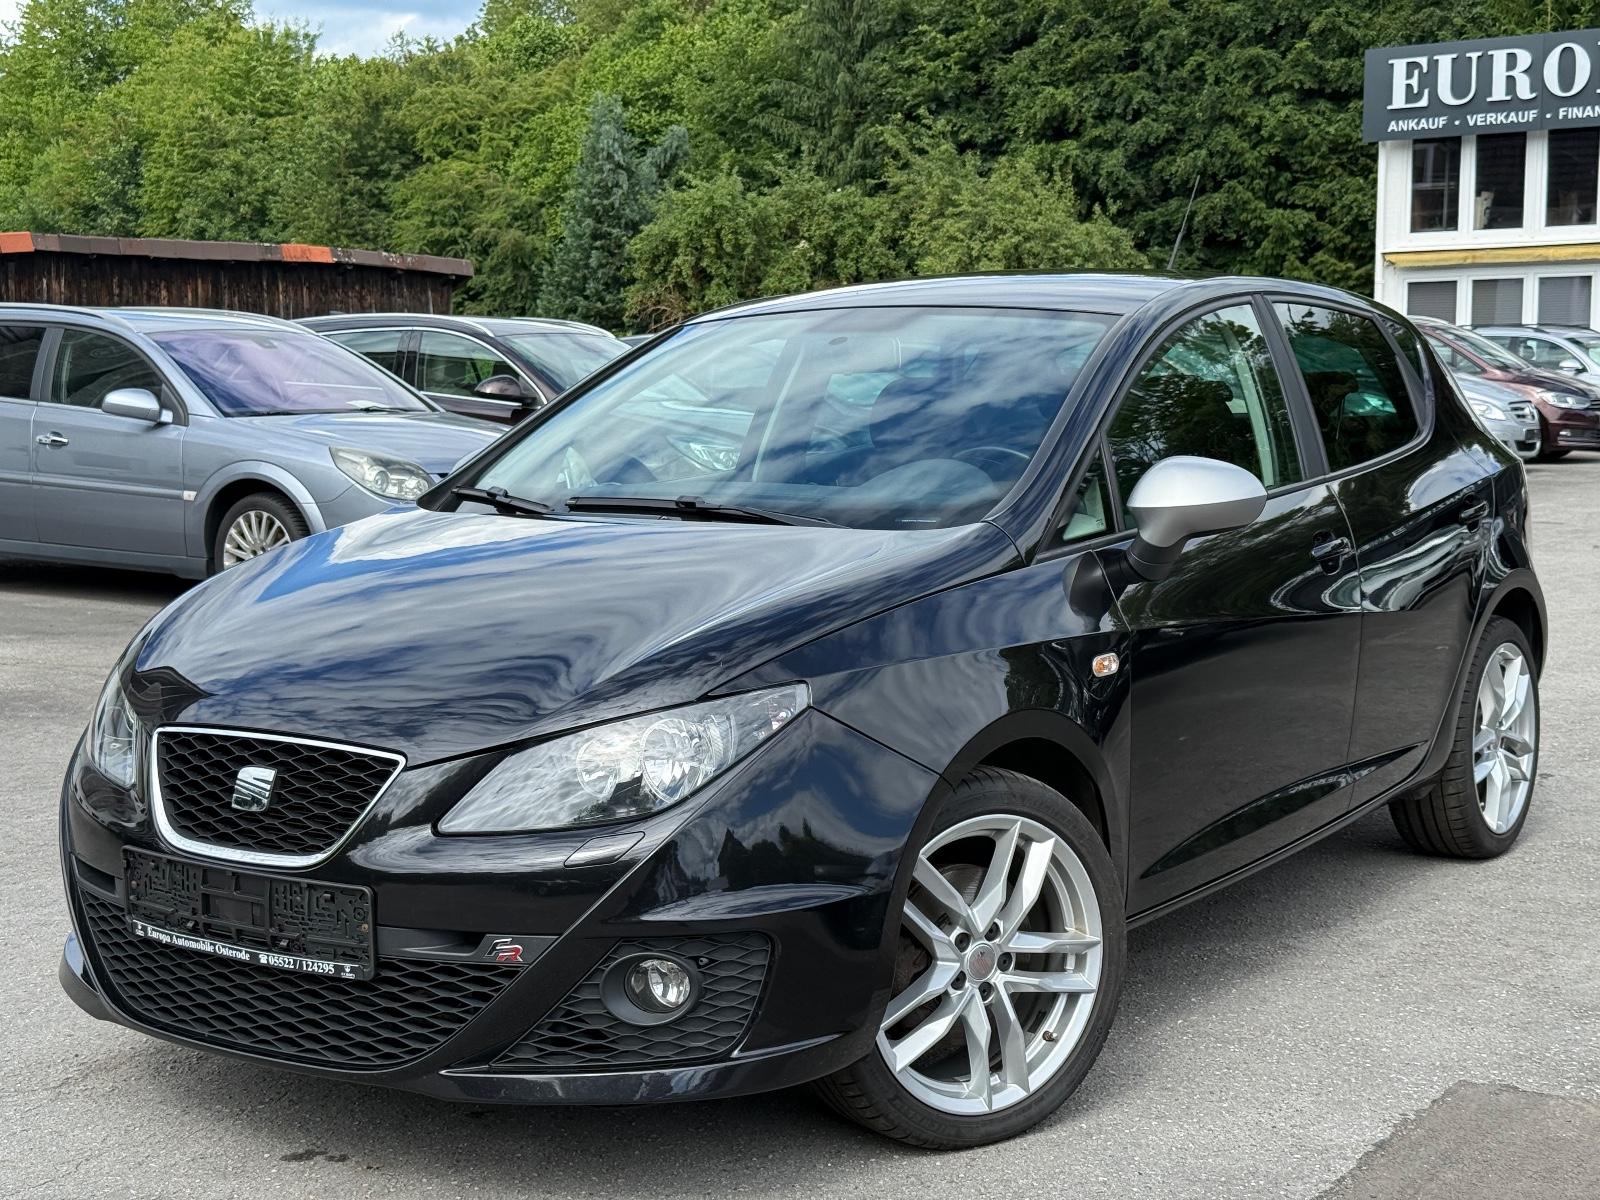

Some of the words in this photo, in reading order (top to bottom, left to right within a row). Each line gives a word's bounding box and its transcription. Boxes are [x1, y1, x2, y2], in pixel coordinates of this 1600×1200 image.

[1386, 41, 1600, 110] EURO
[1387, 115, 1448, 132] ANKAUF
[1466, 109, 1539, 127] VERKAUF
[147, 926, 171, 944] Europa
[171, 935, 215, 953] Automobile
[215, 943, 250, 961] Osterode
[268, 955, 295, 969] 05522
[302, 960, 335, 975] 124295
